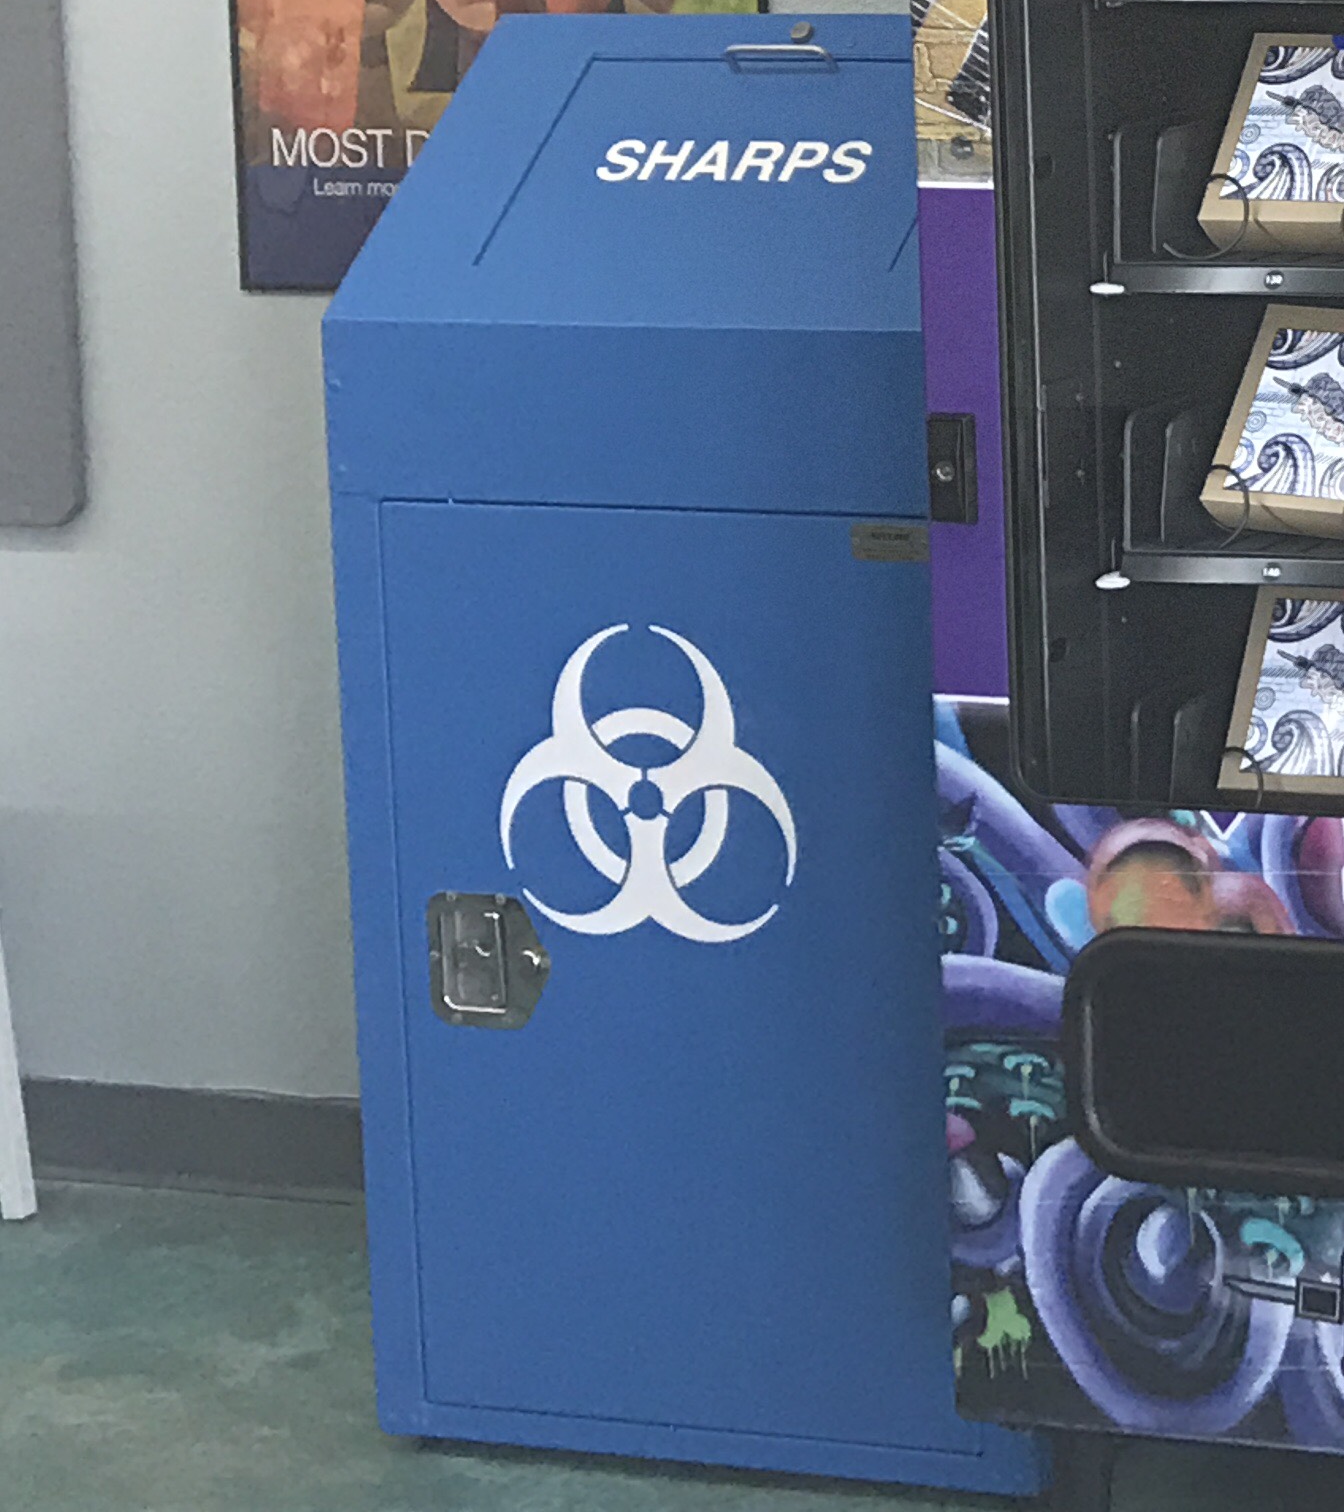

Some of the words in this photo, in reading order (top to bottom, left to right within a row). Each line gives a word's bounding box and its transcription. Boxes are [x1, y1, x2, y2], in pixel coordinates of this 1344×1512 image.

[271, 128, 392, 168] MOST
[596, 139, 872, 183] SHARPS
[313, 178, 363, 197] Learn
